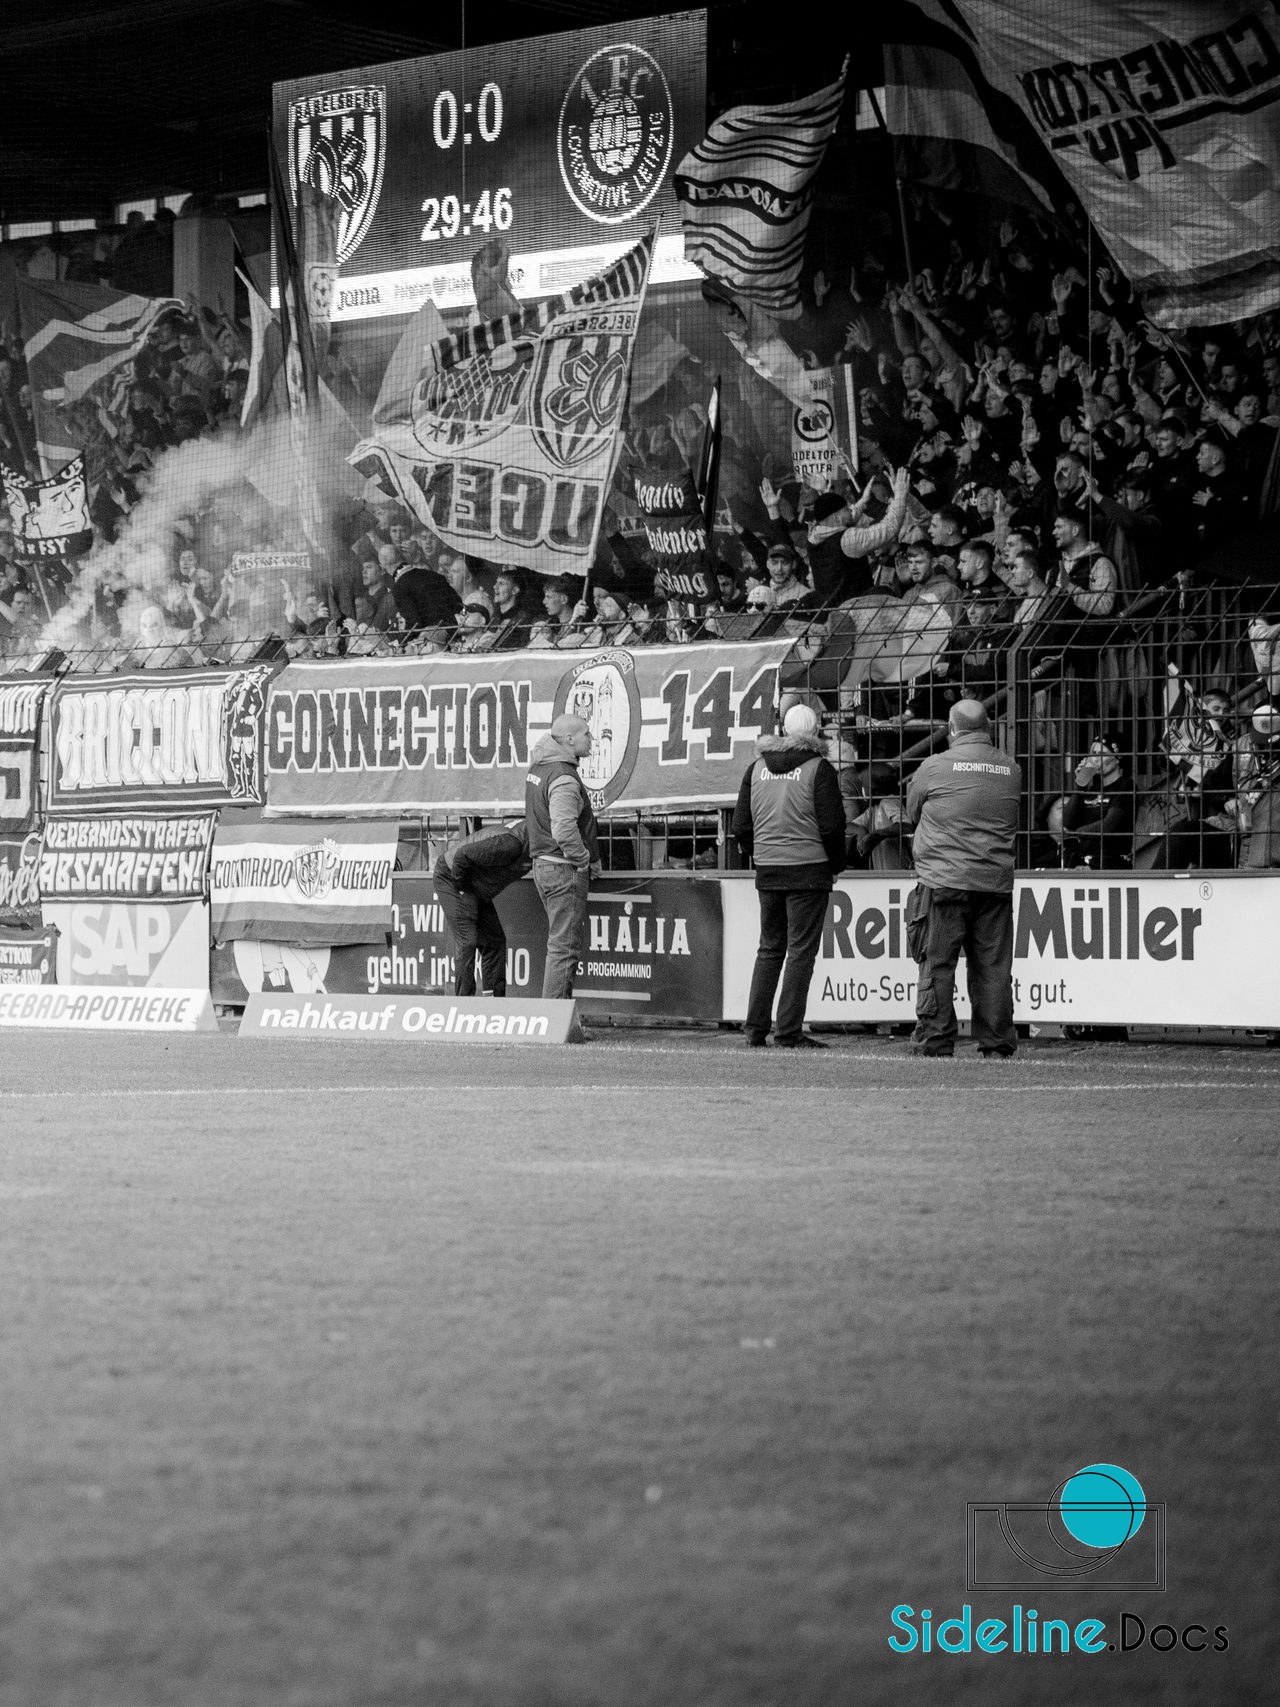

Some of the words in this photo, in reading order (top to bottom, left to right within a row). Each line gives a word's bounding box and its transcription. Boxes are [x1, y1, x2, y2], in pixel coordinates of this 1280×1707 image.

[433, 83, 504, 148] 0:0
[420, 187, 513, 242] 29:46
[268, 680, 532, 774] CONNECTION
[658, 665, 781, 766] 144
[952, 762, 1013, 777] ABSCHNITTSLEITER
[46, 818, 212, 851] VERBANDSSTRAFEN
[39, 851, 205, 892] ABSCHAFFEN!
[331, 859, 391, 891] JUGEND
[71, 903, 171, 977] SAP
[1014, 886, 1202, 961] Müller
[587, 961, 652, 979] PROGRAMMKINO
[821, 976, 966, 1001] Auto-Sere.
[1030, 983, 1074, 1011] gut.
[260, 1000, 396, 1033] nahkauf
[401, 1004, 549, 1036] Oelmann
